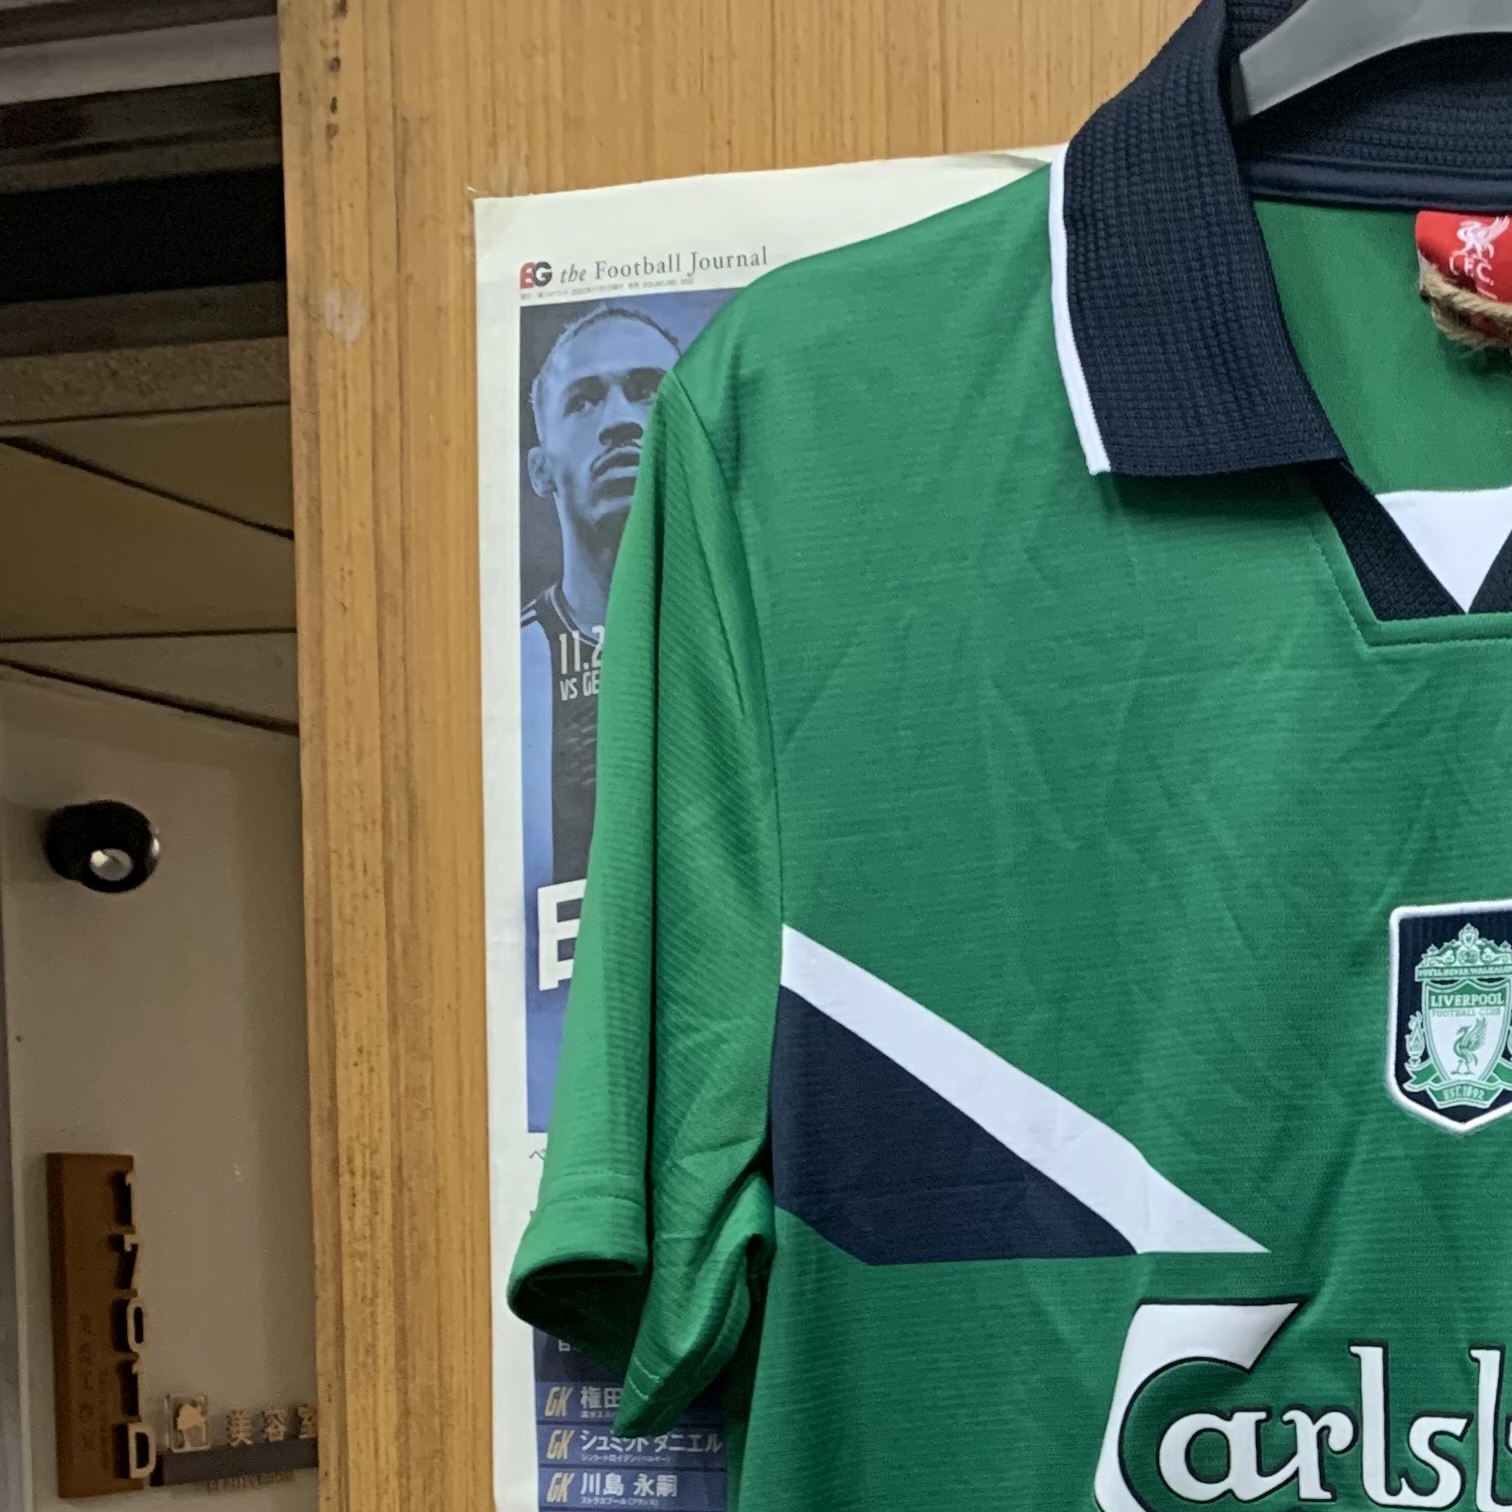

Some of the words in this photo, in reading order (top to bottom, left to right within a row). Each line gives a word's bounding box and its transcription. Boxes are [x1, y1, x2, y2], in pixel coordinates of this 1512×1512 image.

[560, 263, 587, 284] the
[594, 252, 681, 280] Football
[686, 245, 768, 277] Journal
[560, 677, 578, 701] VS
[583, 670, 600, 697] GE
[1430, 992, 1505, 1008] LIVERPOOL
[1431, 1008, 1477, 1018] FOOTBALL
[545, 1386, 573, 1417] GK
[546, 1429, 575, 1460] GK
[653, 1432, 723, 1454] ダニエル
[546, 1472, 574, 1503] GK
[580, 1472, 625, 1497] 川島
[633, 1473, 678, 1498] 永嗣
